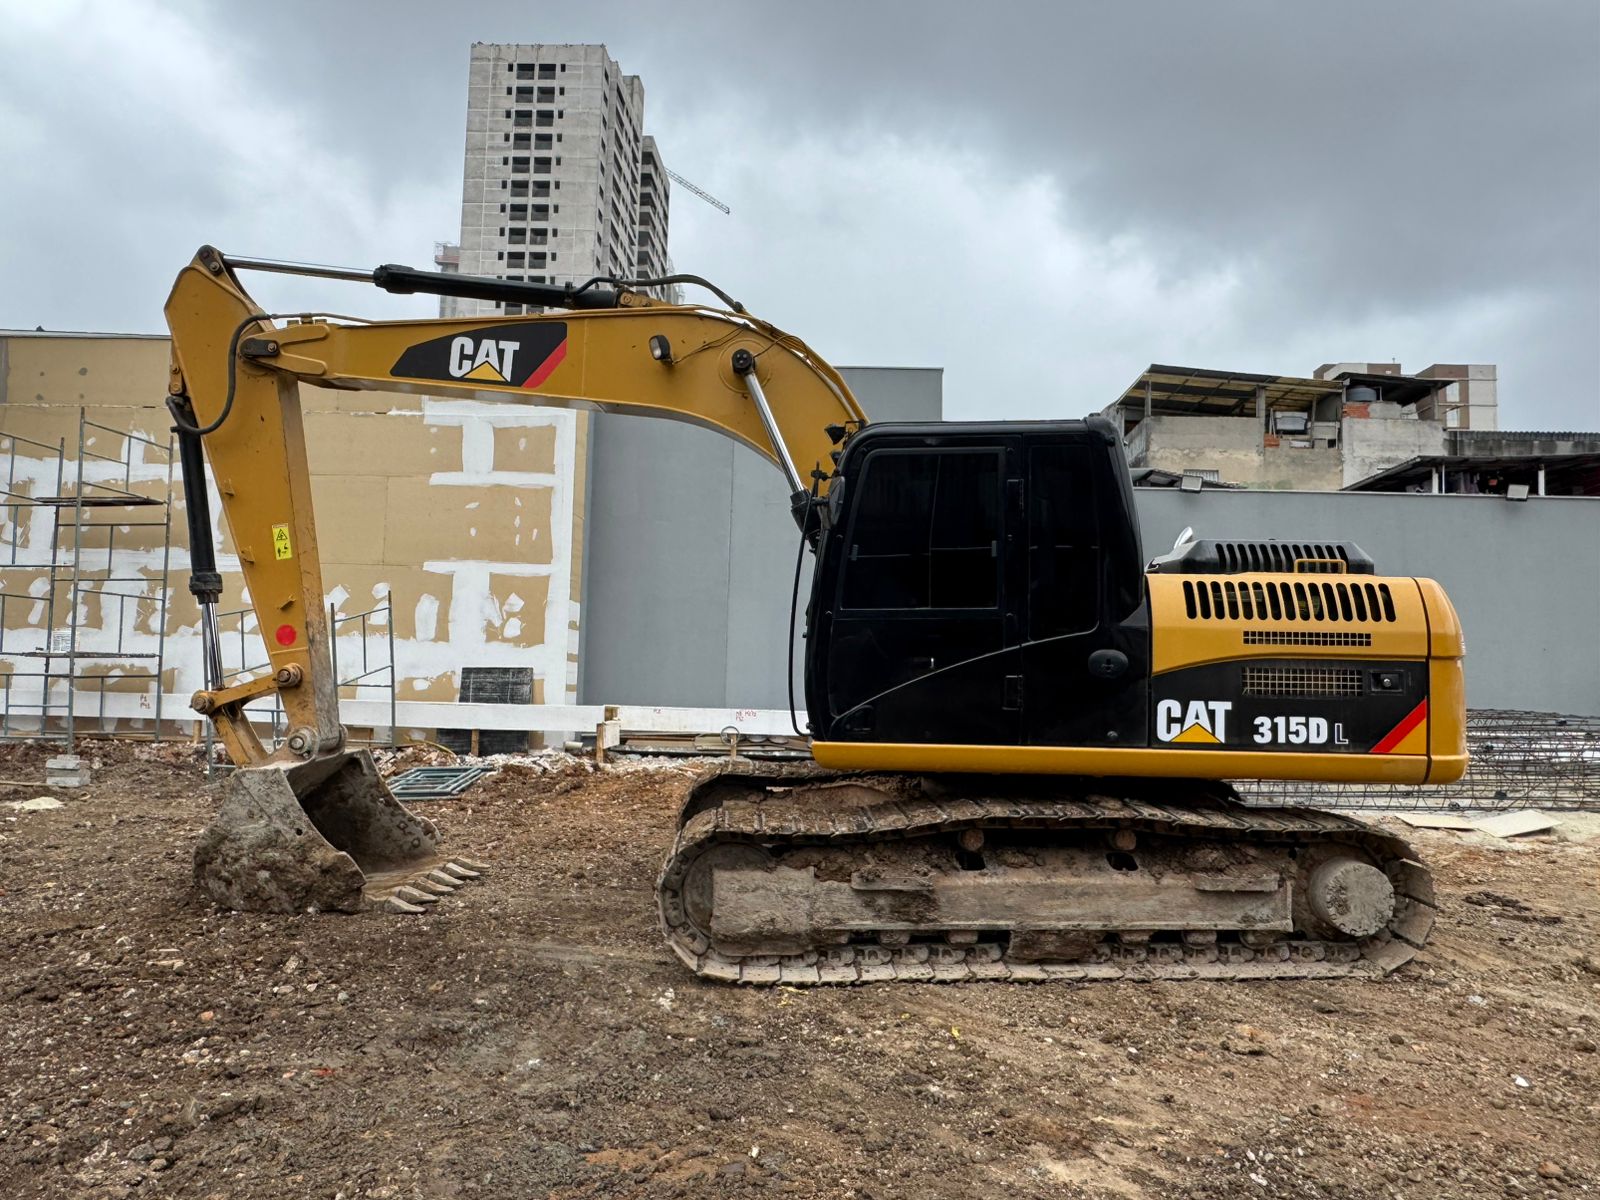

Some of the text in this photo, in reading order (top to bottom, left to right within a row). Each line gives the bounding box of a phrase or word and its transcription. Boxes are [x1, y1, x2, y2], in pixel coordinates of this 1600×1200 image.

[449, 336, 520, 382] CAT
[1156, 699, 1232, 744] CAT
[1253, 716, 1349, 745] 315D L
